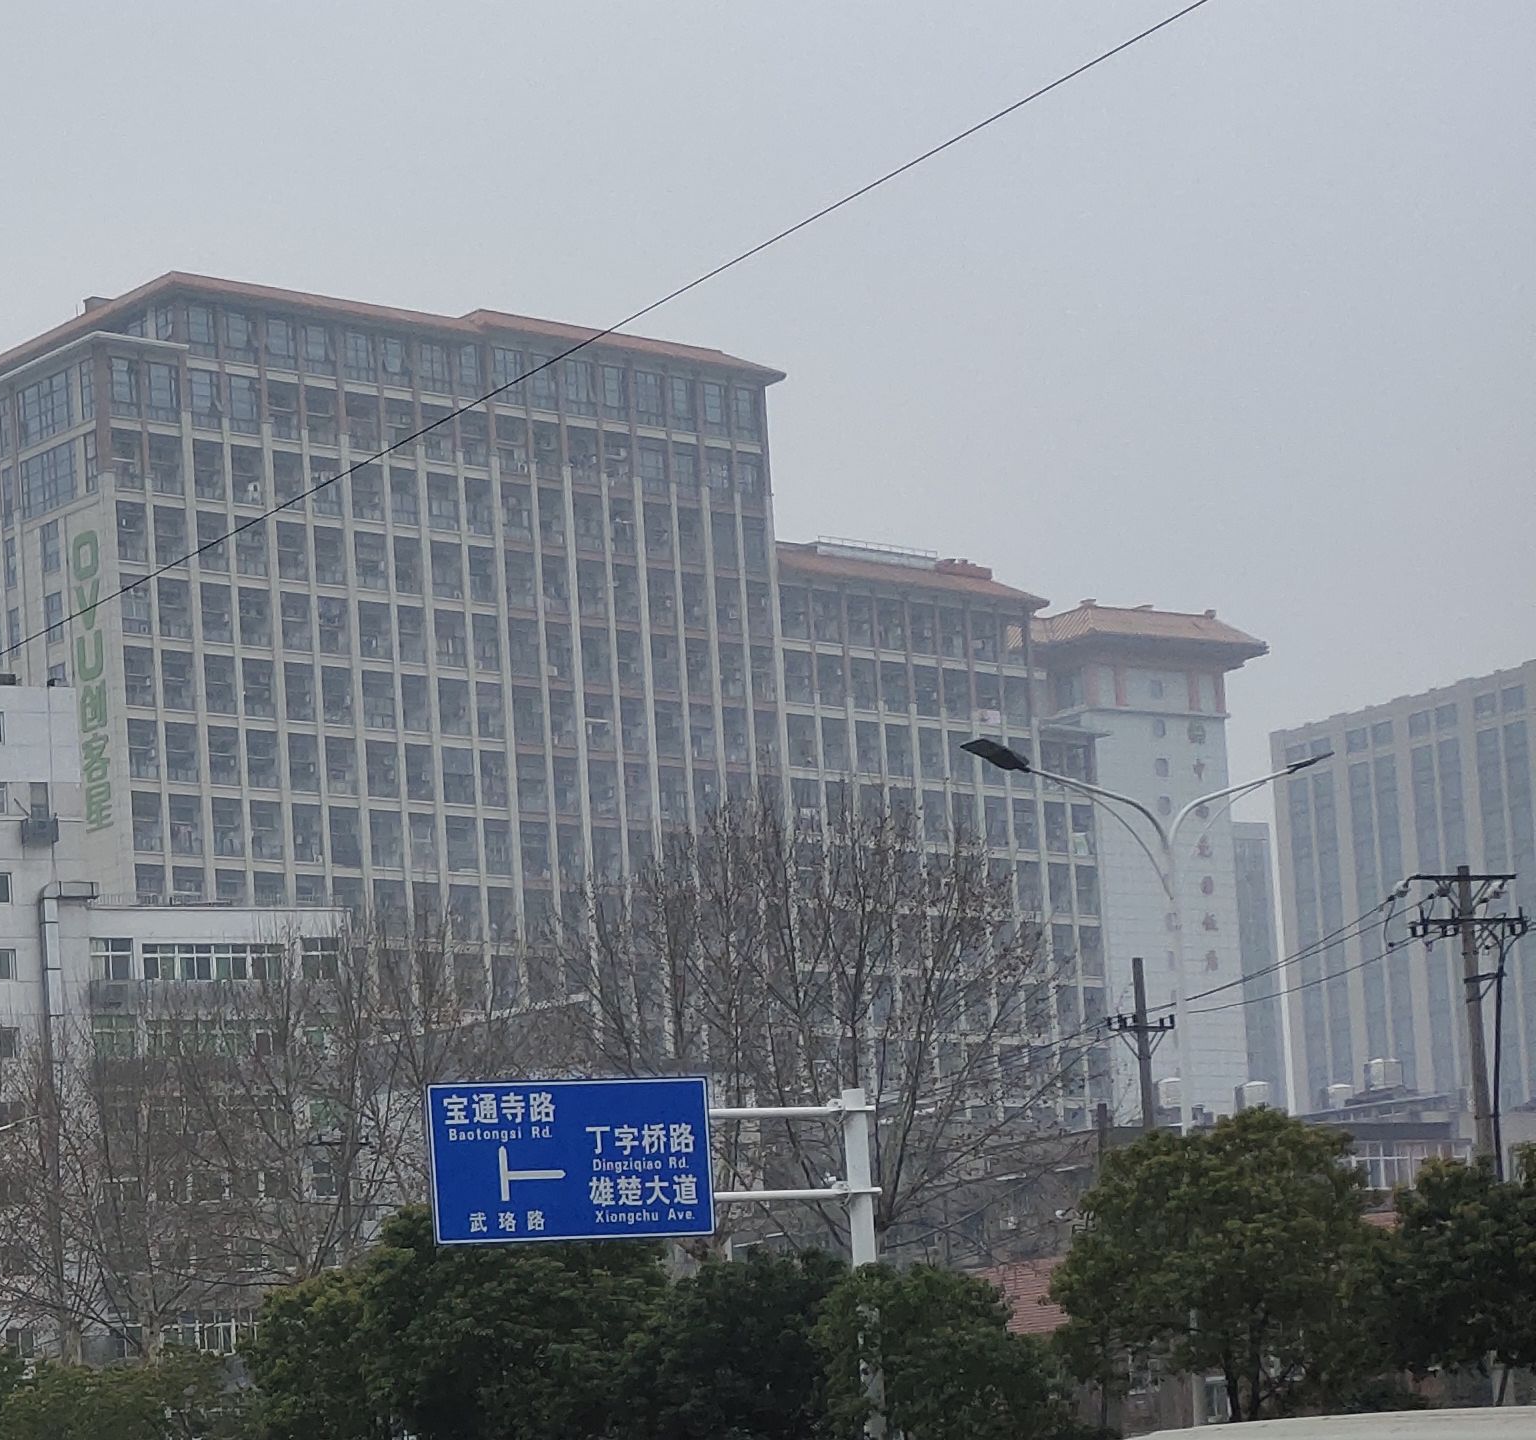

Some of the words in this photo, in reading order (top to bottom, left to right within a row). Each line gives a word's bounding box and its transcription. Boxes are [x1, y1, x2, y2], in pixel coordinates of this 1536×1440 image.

[72, 529, 114, 834] OVU创客星
[443, 1092, 555, 1125] 宝通寺路
[449, 1128, 522, 1142] Baotongsi
[532, 1127, 553, 1139] Rd.
[586, 1123, 695, 1155] 丁字桥路
[592, 1157, 662, 1173] Dingziqiao
[668, 1156, 689, 1169] Rd.
[589, 1174, 698, 1206] 雄楚大道
[469, 1209, 545, 1233] 武珞路
[595, 1209, 659, 1224] Xiongchu
[668, 1208, 695, 1221] Ave.
